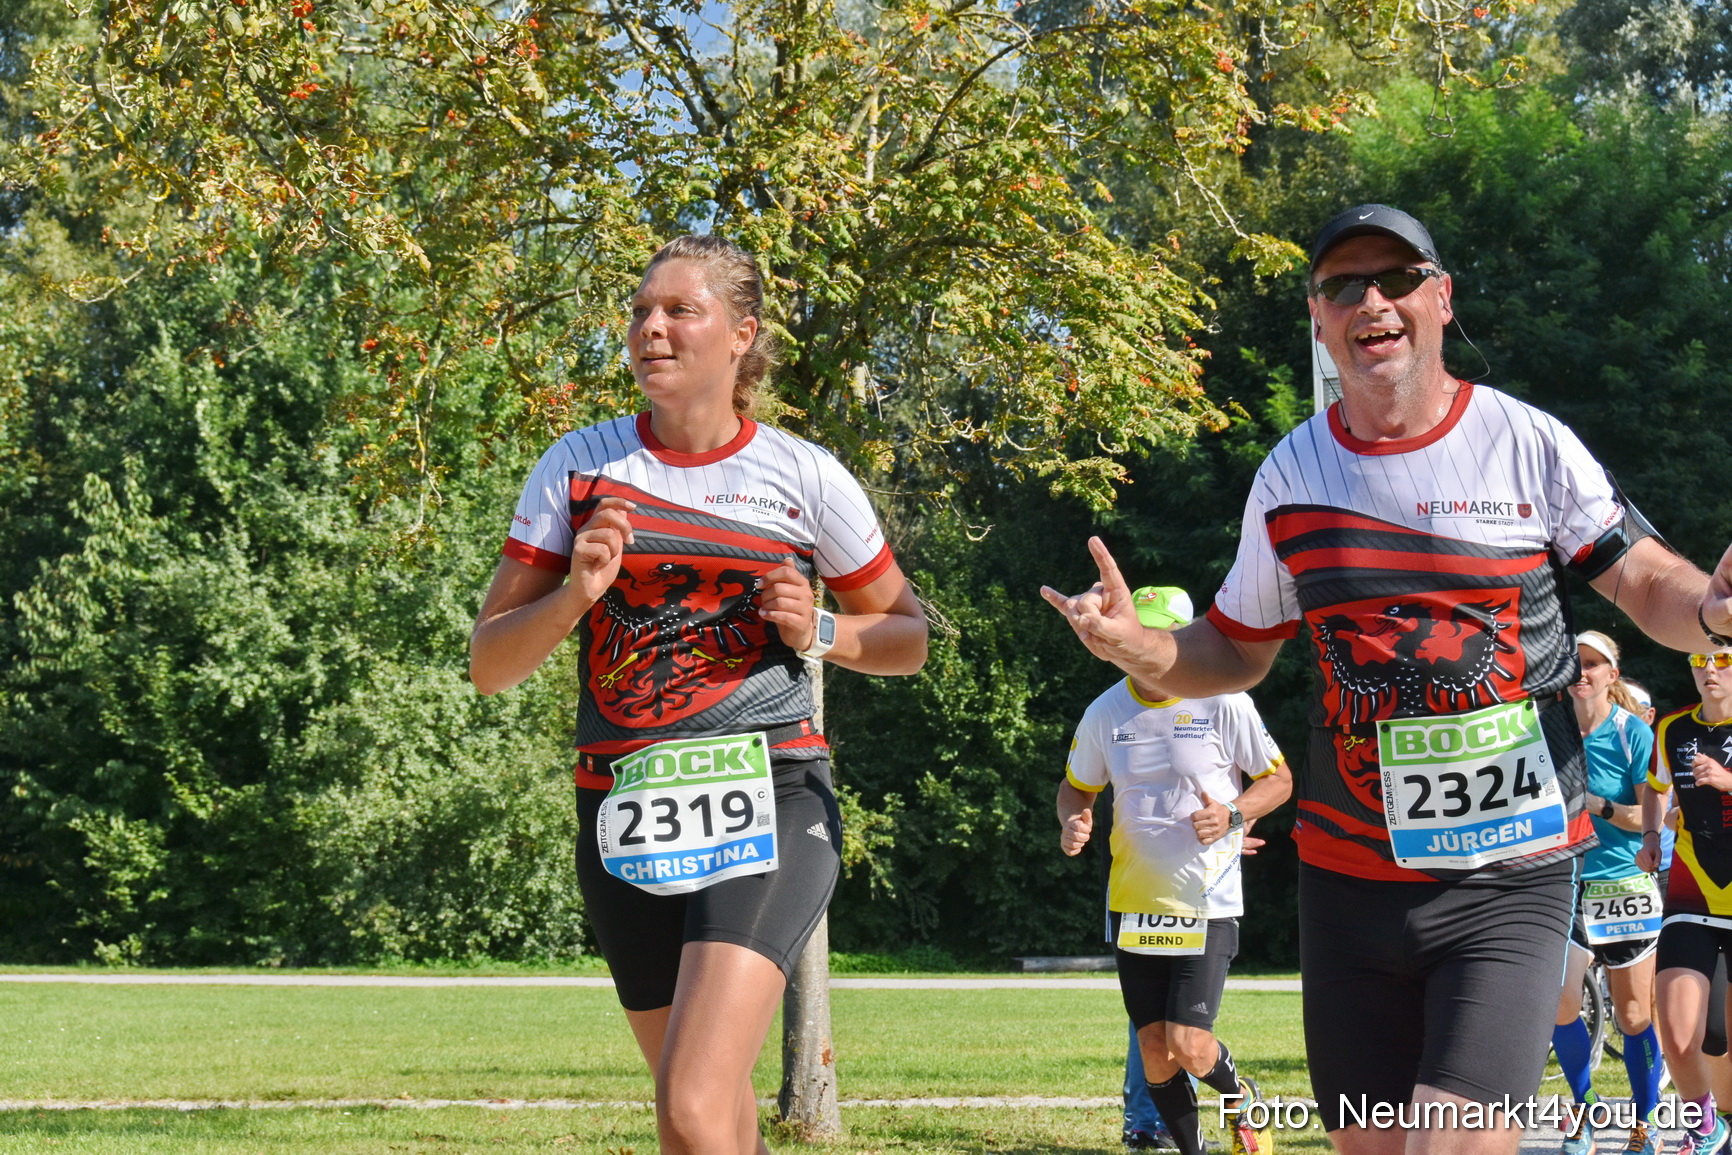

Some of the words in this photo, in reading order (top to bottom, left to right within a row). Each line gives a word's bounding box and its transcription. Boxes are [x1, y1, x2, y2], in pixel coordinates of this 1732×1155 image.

[704, 494, 786, 514] NEUMARKT
[1417, 500, 1514, 516] NEUMARKT
[1175, 714, 1192, 725] 20
[1392, 708, 1533, 759] BOCK
[619, 742, 755, 788] BOCK
[1402, 757, 1542, 820] 2324
[617, 790, 754, 847] 2319
[1427, 818, 1533, 853] JÜRGEN
[620, 843, 760, 881] CHRISTINA
[1588, 880, 1650, 897] BOCK
[1592, 895, 1653, 920] 2463
[1139, 936, 1183, 945] BERND
[1606, 922, 1645, 935] PETRA
